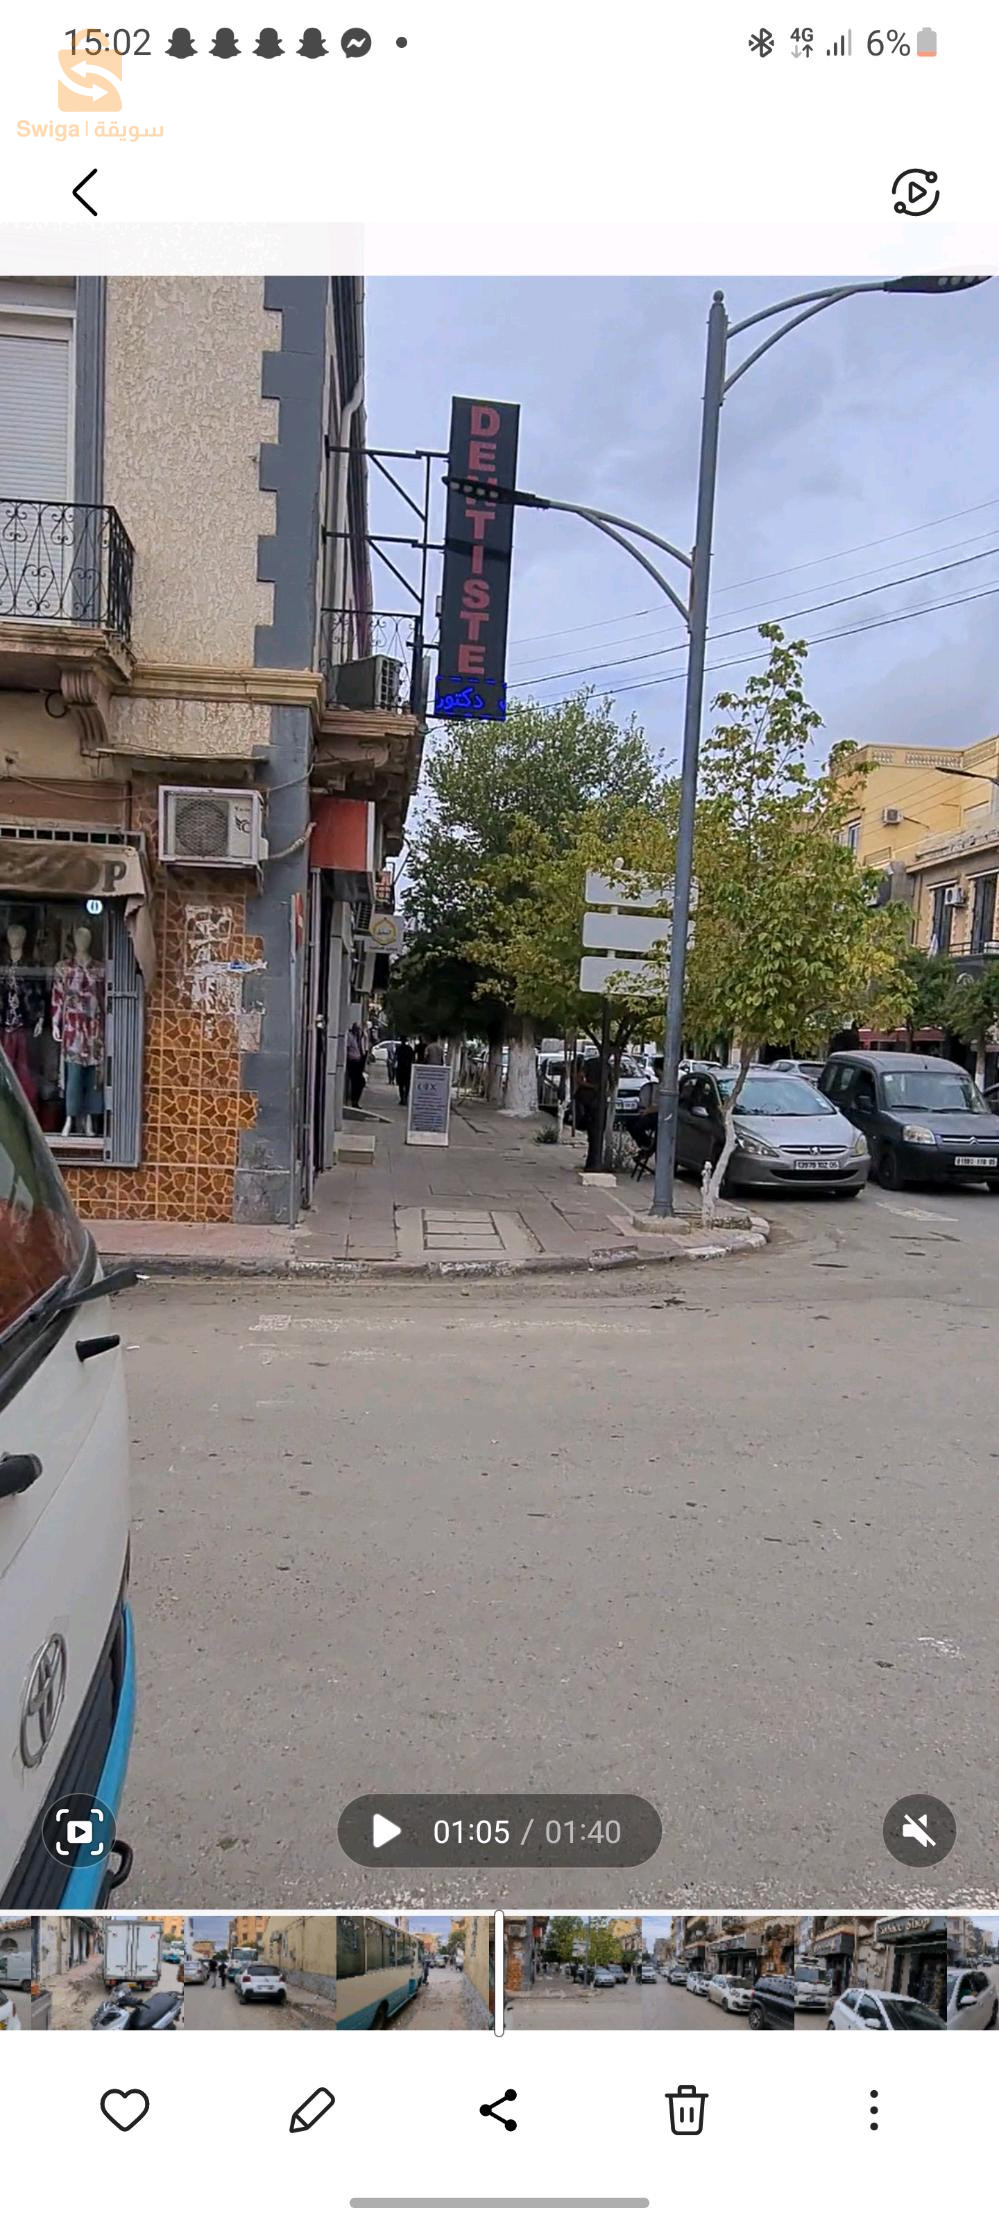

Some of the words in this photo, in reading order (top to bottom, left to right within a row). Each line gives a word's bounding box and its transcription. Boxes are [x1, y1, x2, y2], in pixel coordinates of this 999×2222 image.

[65, 28, 151, 56] 15:02
[790, 28, 814, 42] 4G
[867, 29, 911, 57] 6%
[432, 1818, 510, 1845] 01:05
[545, 1818, 622, 1845] 01:40
